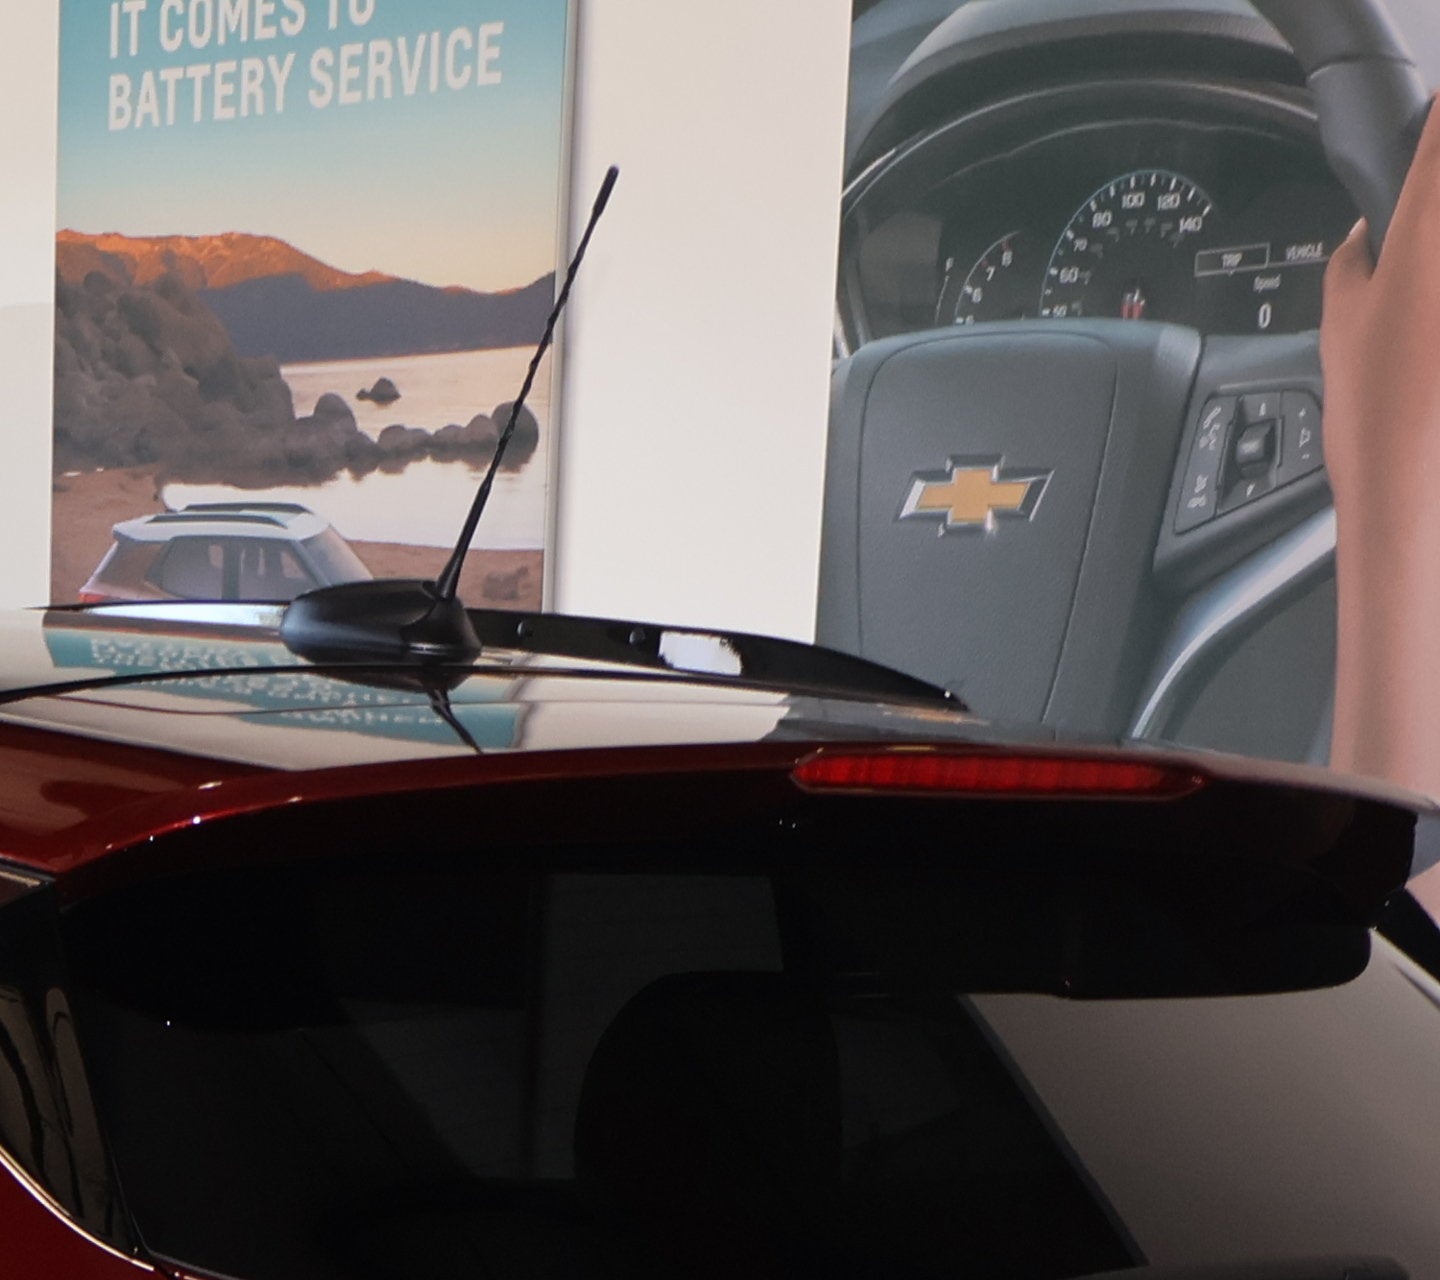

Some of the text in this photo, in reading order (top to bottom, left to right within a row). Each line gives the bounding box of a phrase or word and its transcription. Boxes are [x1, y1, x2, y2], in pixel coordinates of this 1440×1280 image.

[109, 2, 147, 59] IT
[159, 0, 306, 53] COMES
[108, 21, 505, 131] BATTERY SERVICE
[1122, 191, 1181, 210] 100 120
[1092, 210, 1112, 228] 80
[1179, 216, 1203, 234] 140
[1222, 243, 1324, 268] TRIP VEHICLE
[1059, 266, 1079, 283] 60
[1258, 302, 1272, 329] 0
